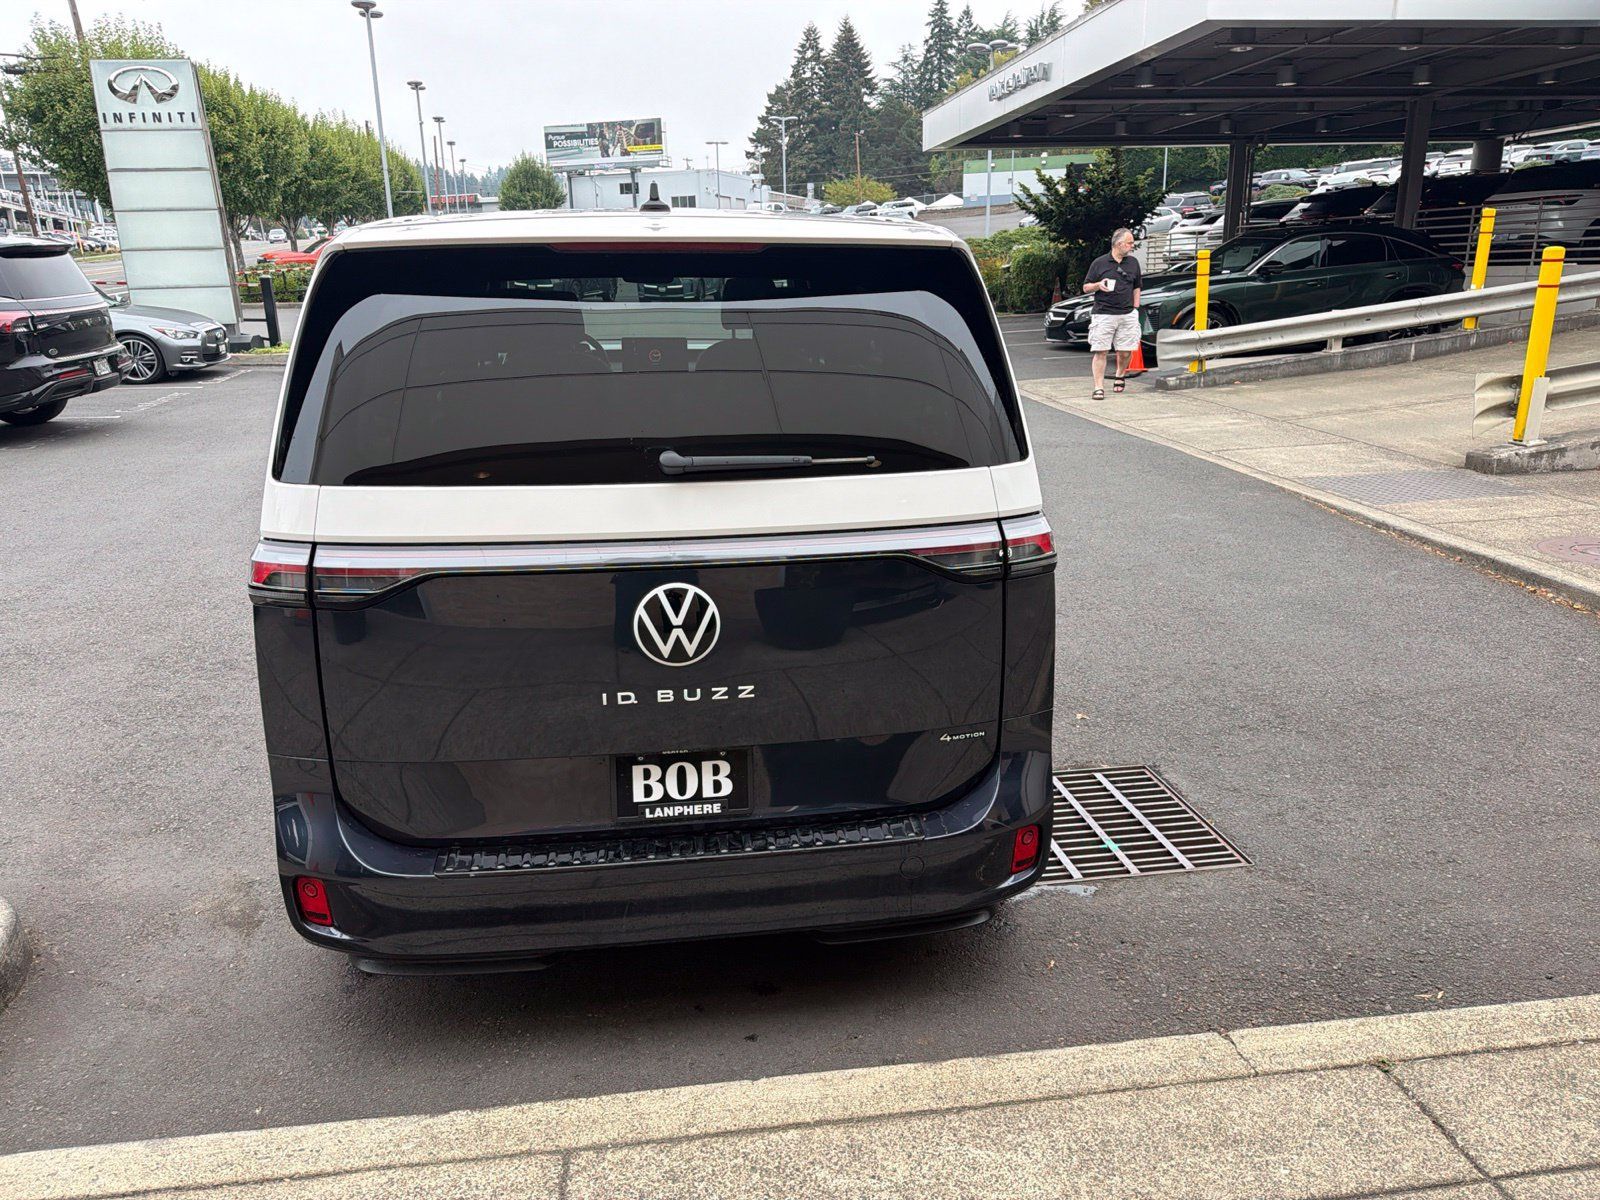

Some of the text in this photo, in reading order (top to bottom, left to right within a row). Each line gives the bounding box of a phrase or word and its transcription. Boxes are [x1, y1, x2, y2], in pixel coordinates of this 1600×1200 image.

[102, 112, 196, 123] INFINITI
[553, 138, 599, 147] POSSIBILITIES
[657, 685, 755, 702] BUZZ
[632, 760, 733, 803] BOB
[645, 803, 722, 819] LANPHERE
